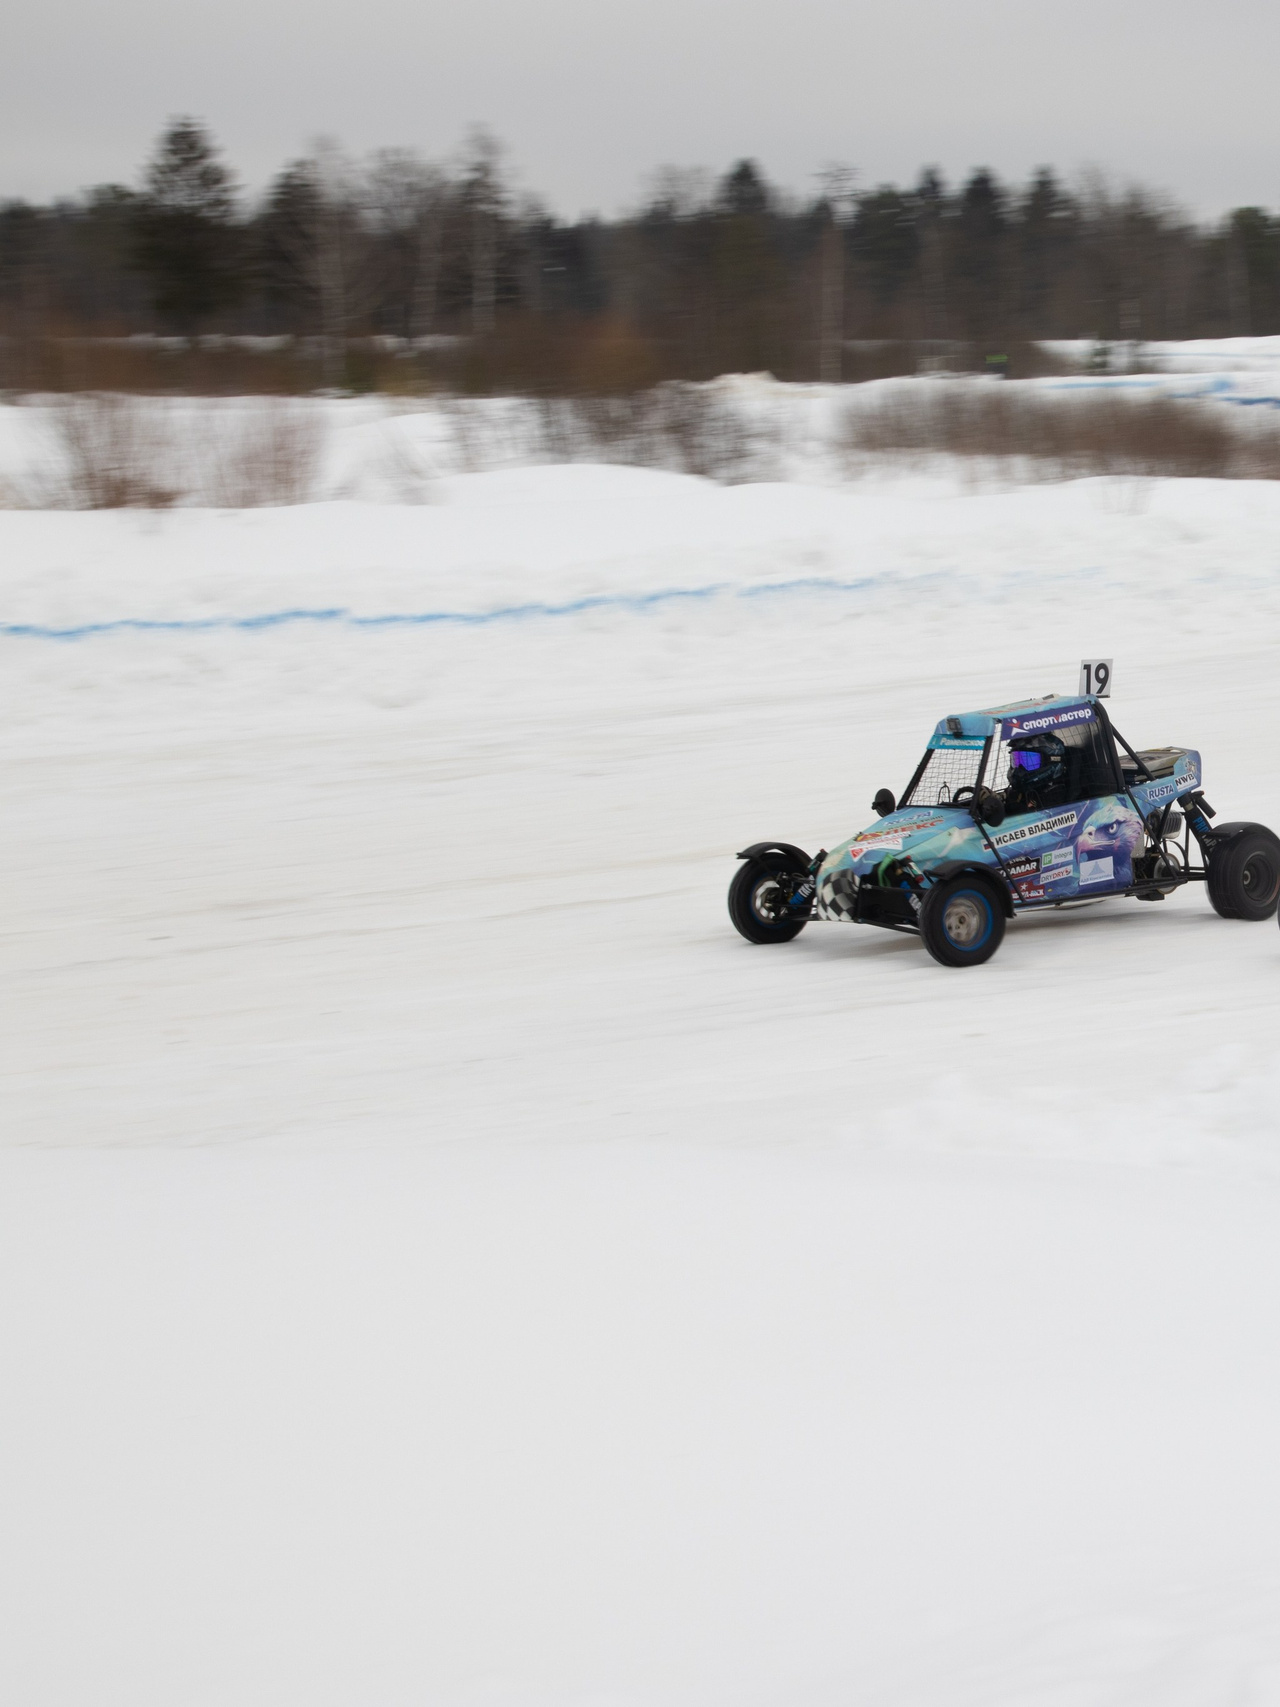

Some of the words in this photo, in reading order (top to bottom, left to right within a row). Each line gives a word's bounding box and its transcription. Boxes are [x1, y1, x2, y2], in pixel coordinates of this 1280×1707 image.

[1083, 663, 1110, 695] 19
[1023, 708, 1092, 730] спортмастер
[1175, 773, 1195, 787] NWB
[1148, 784, 1174, 800] RUSTA
[995, 828, 1026, 846] ИСАЕВ
[1028, 813, 1076, 836] ВЛАДИМИР
[1043, 855, 1051, 864] IP
[1054, 850, 1073, 860] integra
[1041, 871, 1065, 883] DRYDRY
